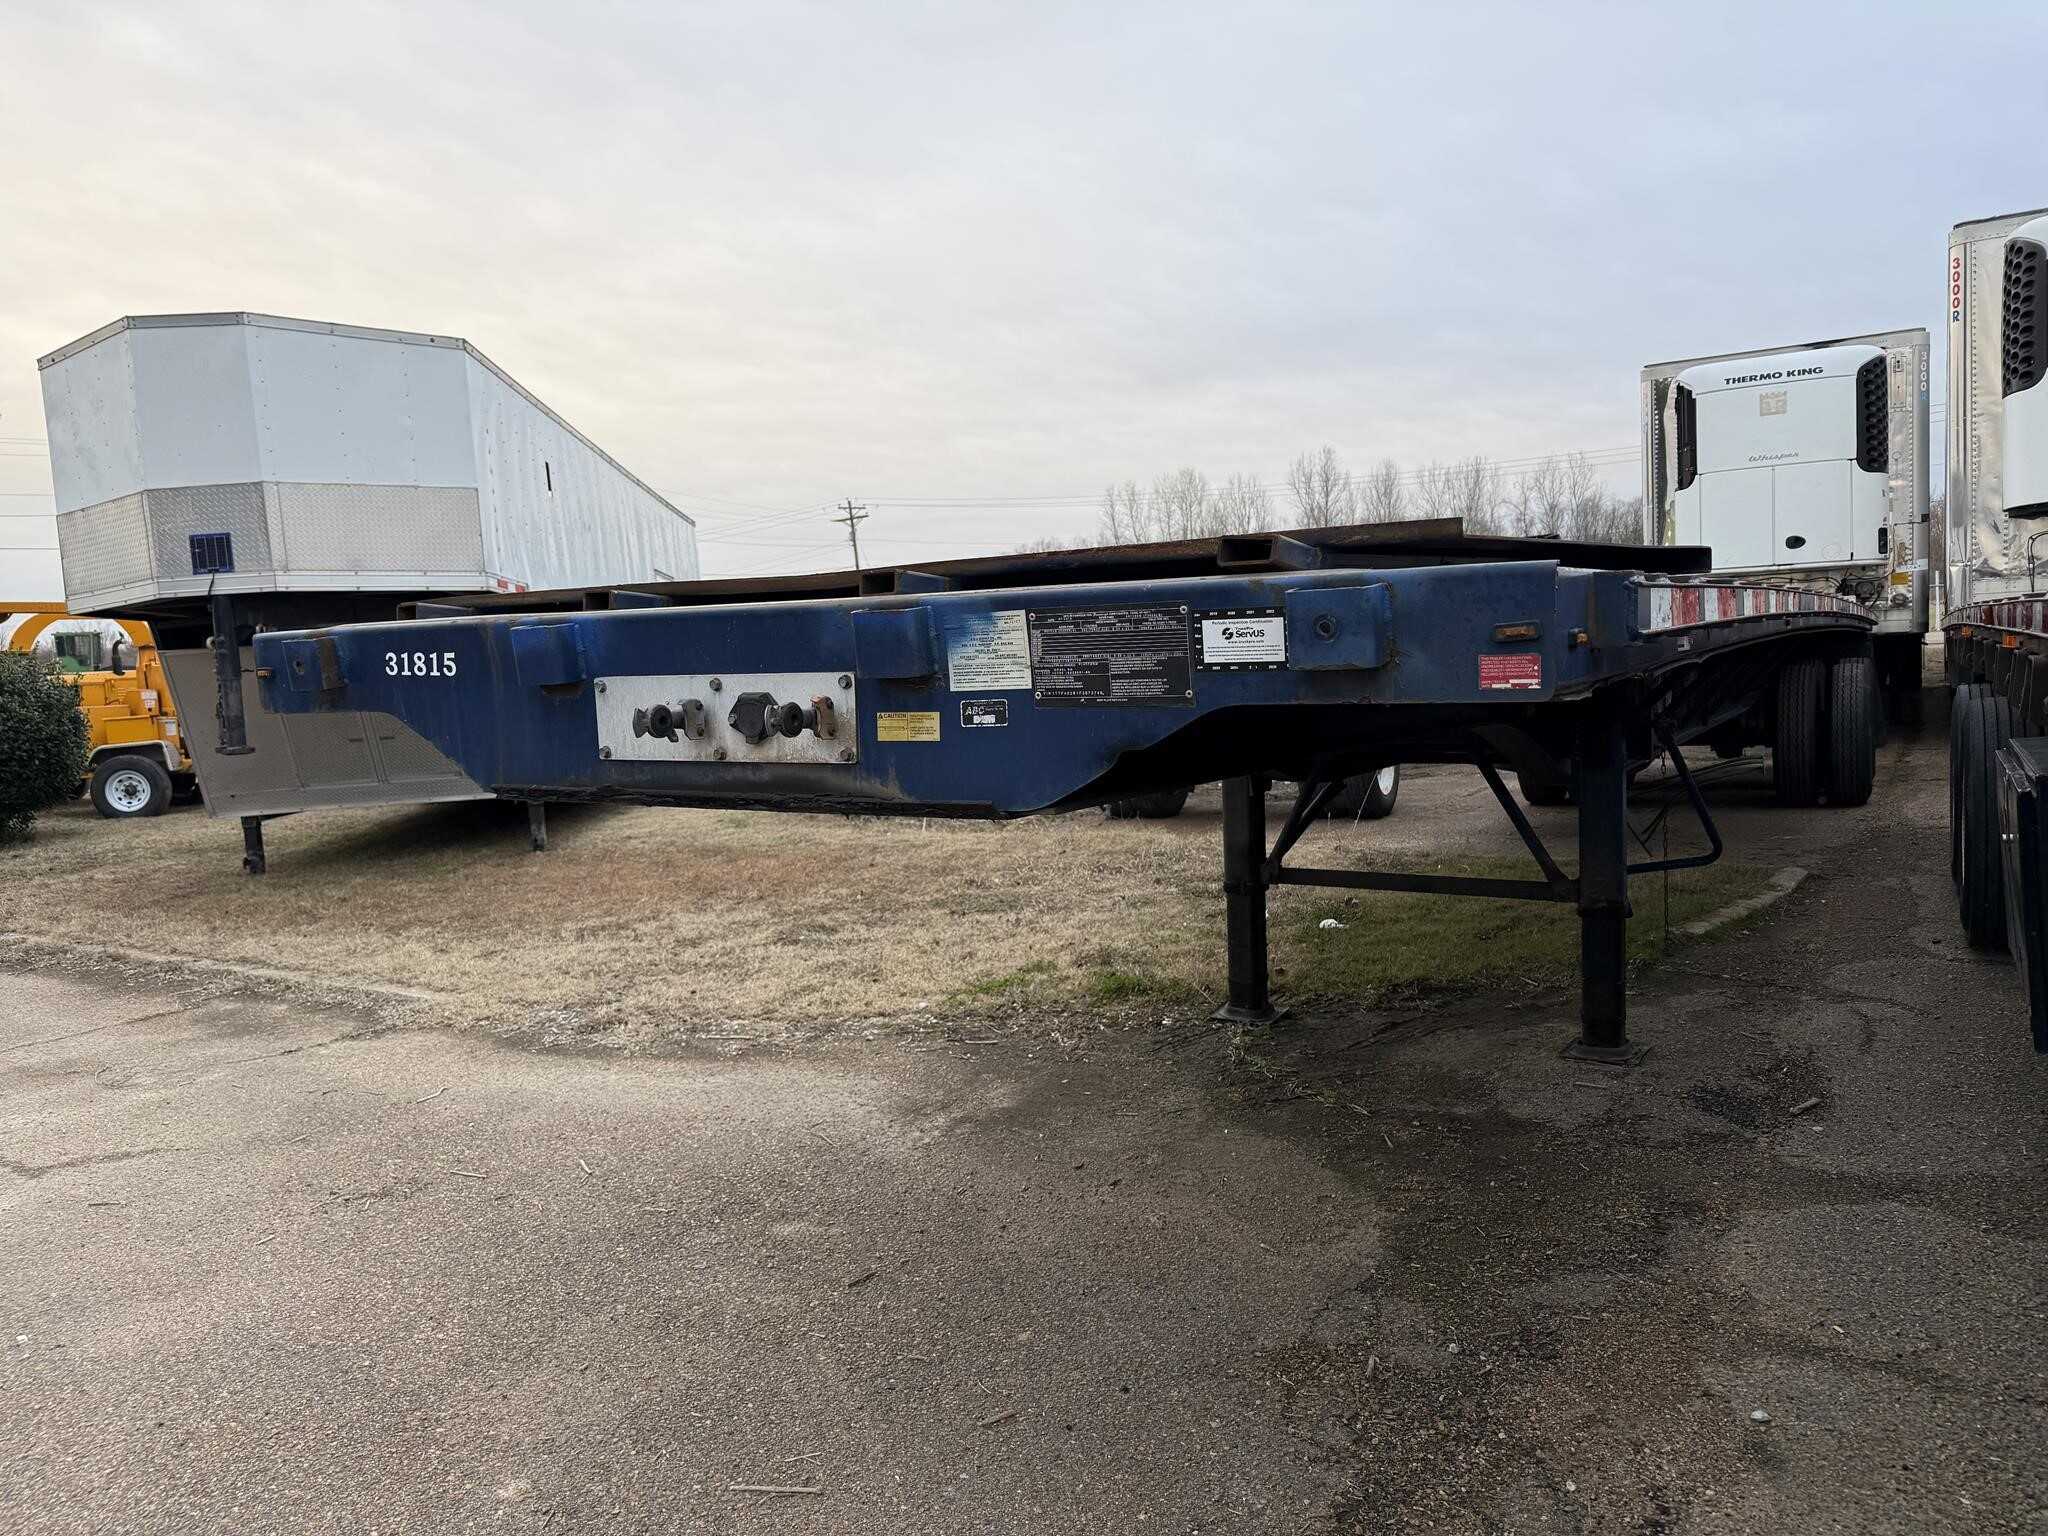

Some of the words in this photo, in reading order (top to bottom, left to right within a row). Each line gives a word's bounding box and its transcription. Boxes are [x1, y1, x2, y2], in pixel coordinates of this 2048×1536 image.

[1952, 257, 1961, 323] 3000R
[1724, 371, 1783, 385] THERMO
[1786, 366, 1824, 378] KING
[1235, 629, 1265, 638] ServUS
[385, 652, 457, 677] 31815
[964, 706, 985, 715] ABC
